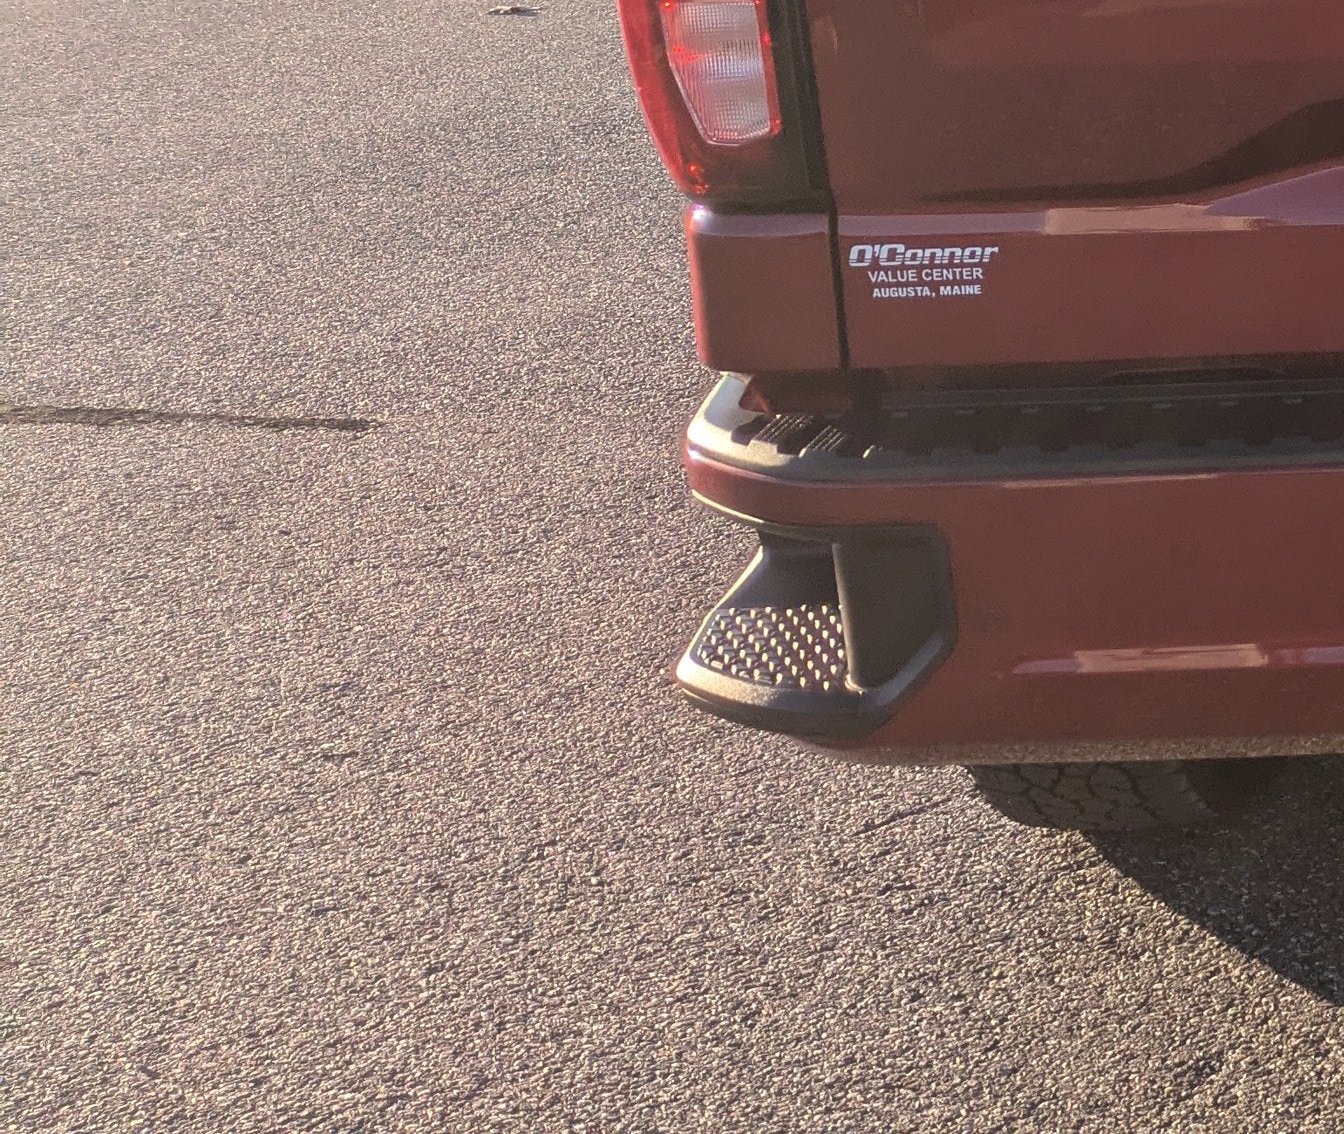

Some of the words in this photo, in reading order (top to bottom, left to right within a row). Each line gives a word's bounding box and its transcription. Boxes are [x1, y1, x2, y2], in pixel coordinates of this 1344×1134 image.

[849, 244, 999, 266] O'Connor
[868, 270, 918, 282] VALUE
[922, 268, 983, 280] CENTER
[872, 286, 936, 298] AUGUSTA,
[939, 284, 982, 295] MAINE
